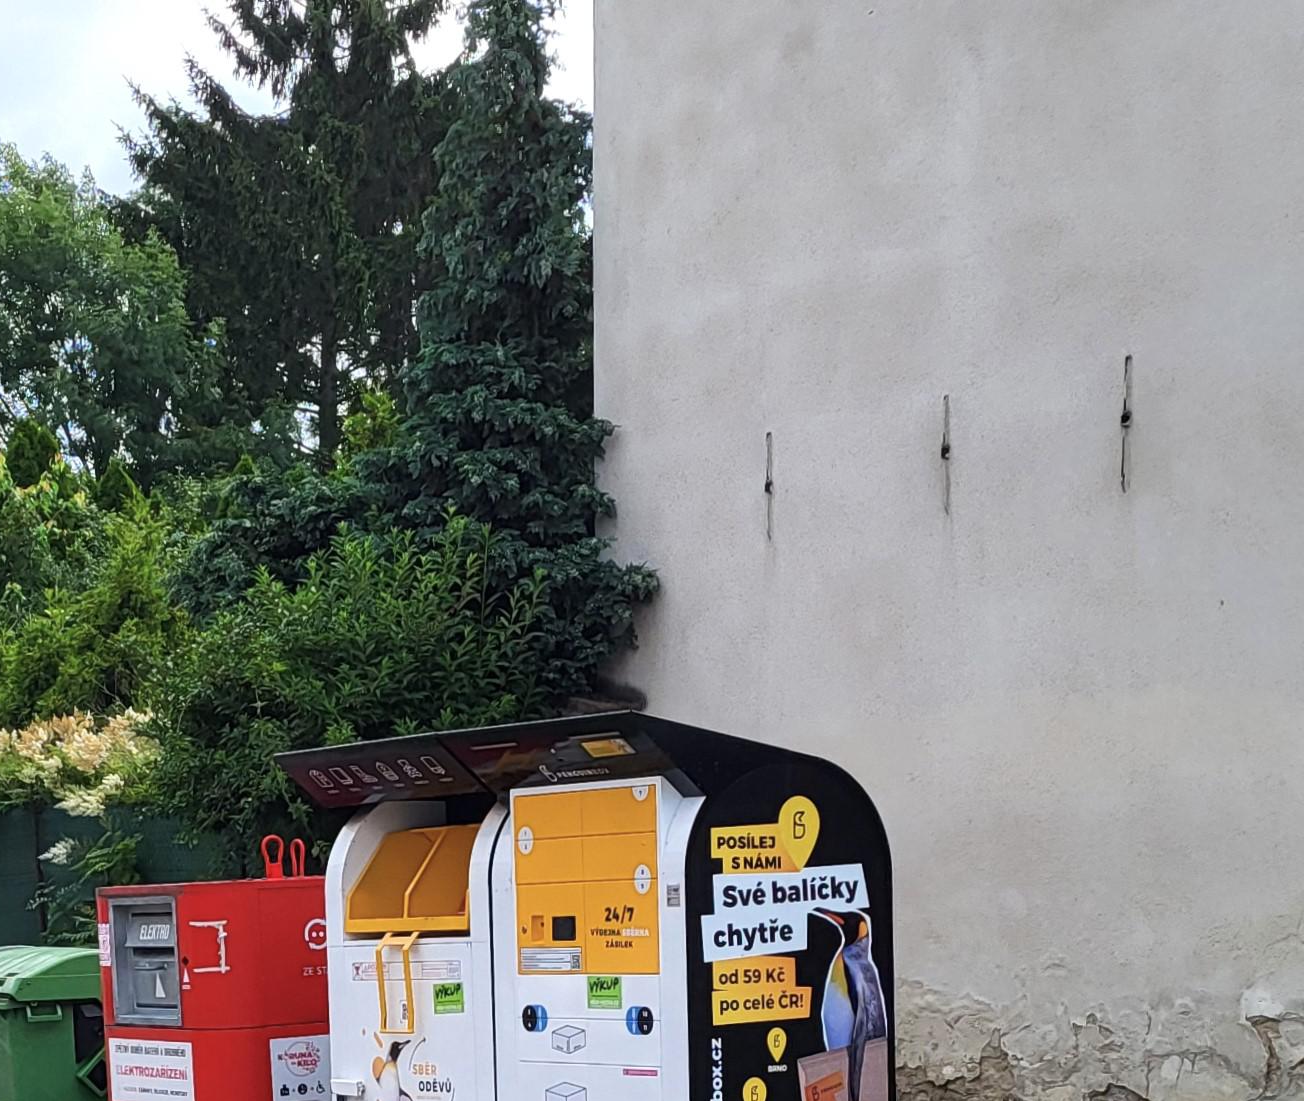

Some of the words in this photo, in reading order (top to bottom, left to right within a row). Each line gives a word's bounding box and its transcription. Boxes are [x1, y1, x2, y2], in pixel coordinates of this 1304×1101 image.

[716, 832, 776, 849] POSÍLEJ
[731, 857, 740, 869] S
[743, 852, 782, 869] NÁMI
[722, 881, 766, 908] Své
[772, 876, 859, 904] balíčky
[604, 904, 634, 924] 24/7
[139, 924, 170, 940] ELEKTRO
[713, 918, 794, 951] chytře
[718, 969, 739, 985] od
[743, 968, 761, 983] 59
[766, 966, 785, 983] Kč
[719, 997, 740, 1015] po
[743, 991, 775, 1011] celé
[778, 989, 804, 1009] ČR!
[116, 1064, 188, 1080] ELEKTROZAŘÍZENÍ
[412, 1061, 437, 1076] SBĚR
[767, 1064, 788, 1073] BRNO
[418, 1077, 452, 1093] ODĚVŮ
